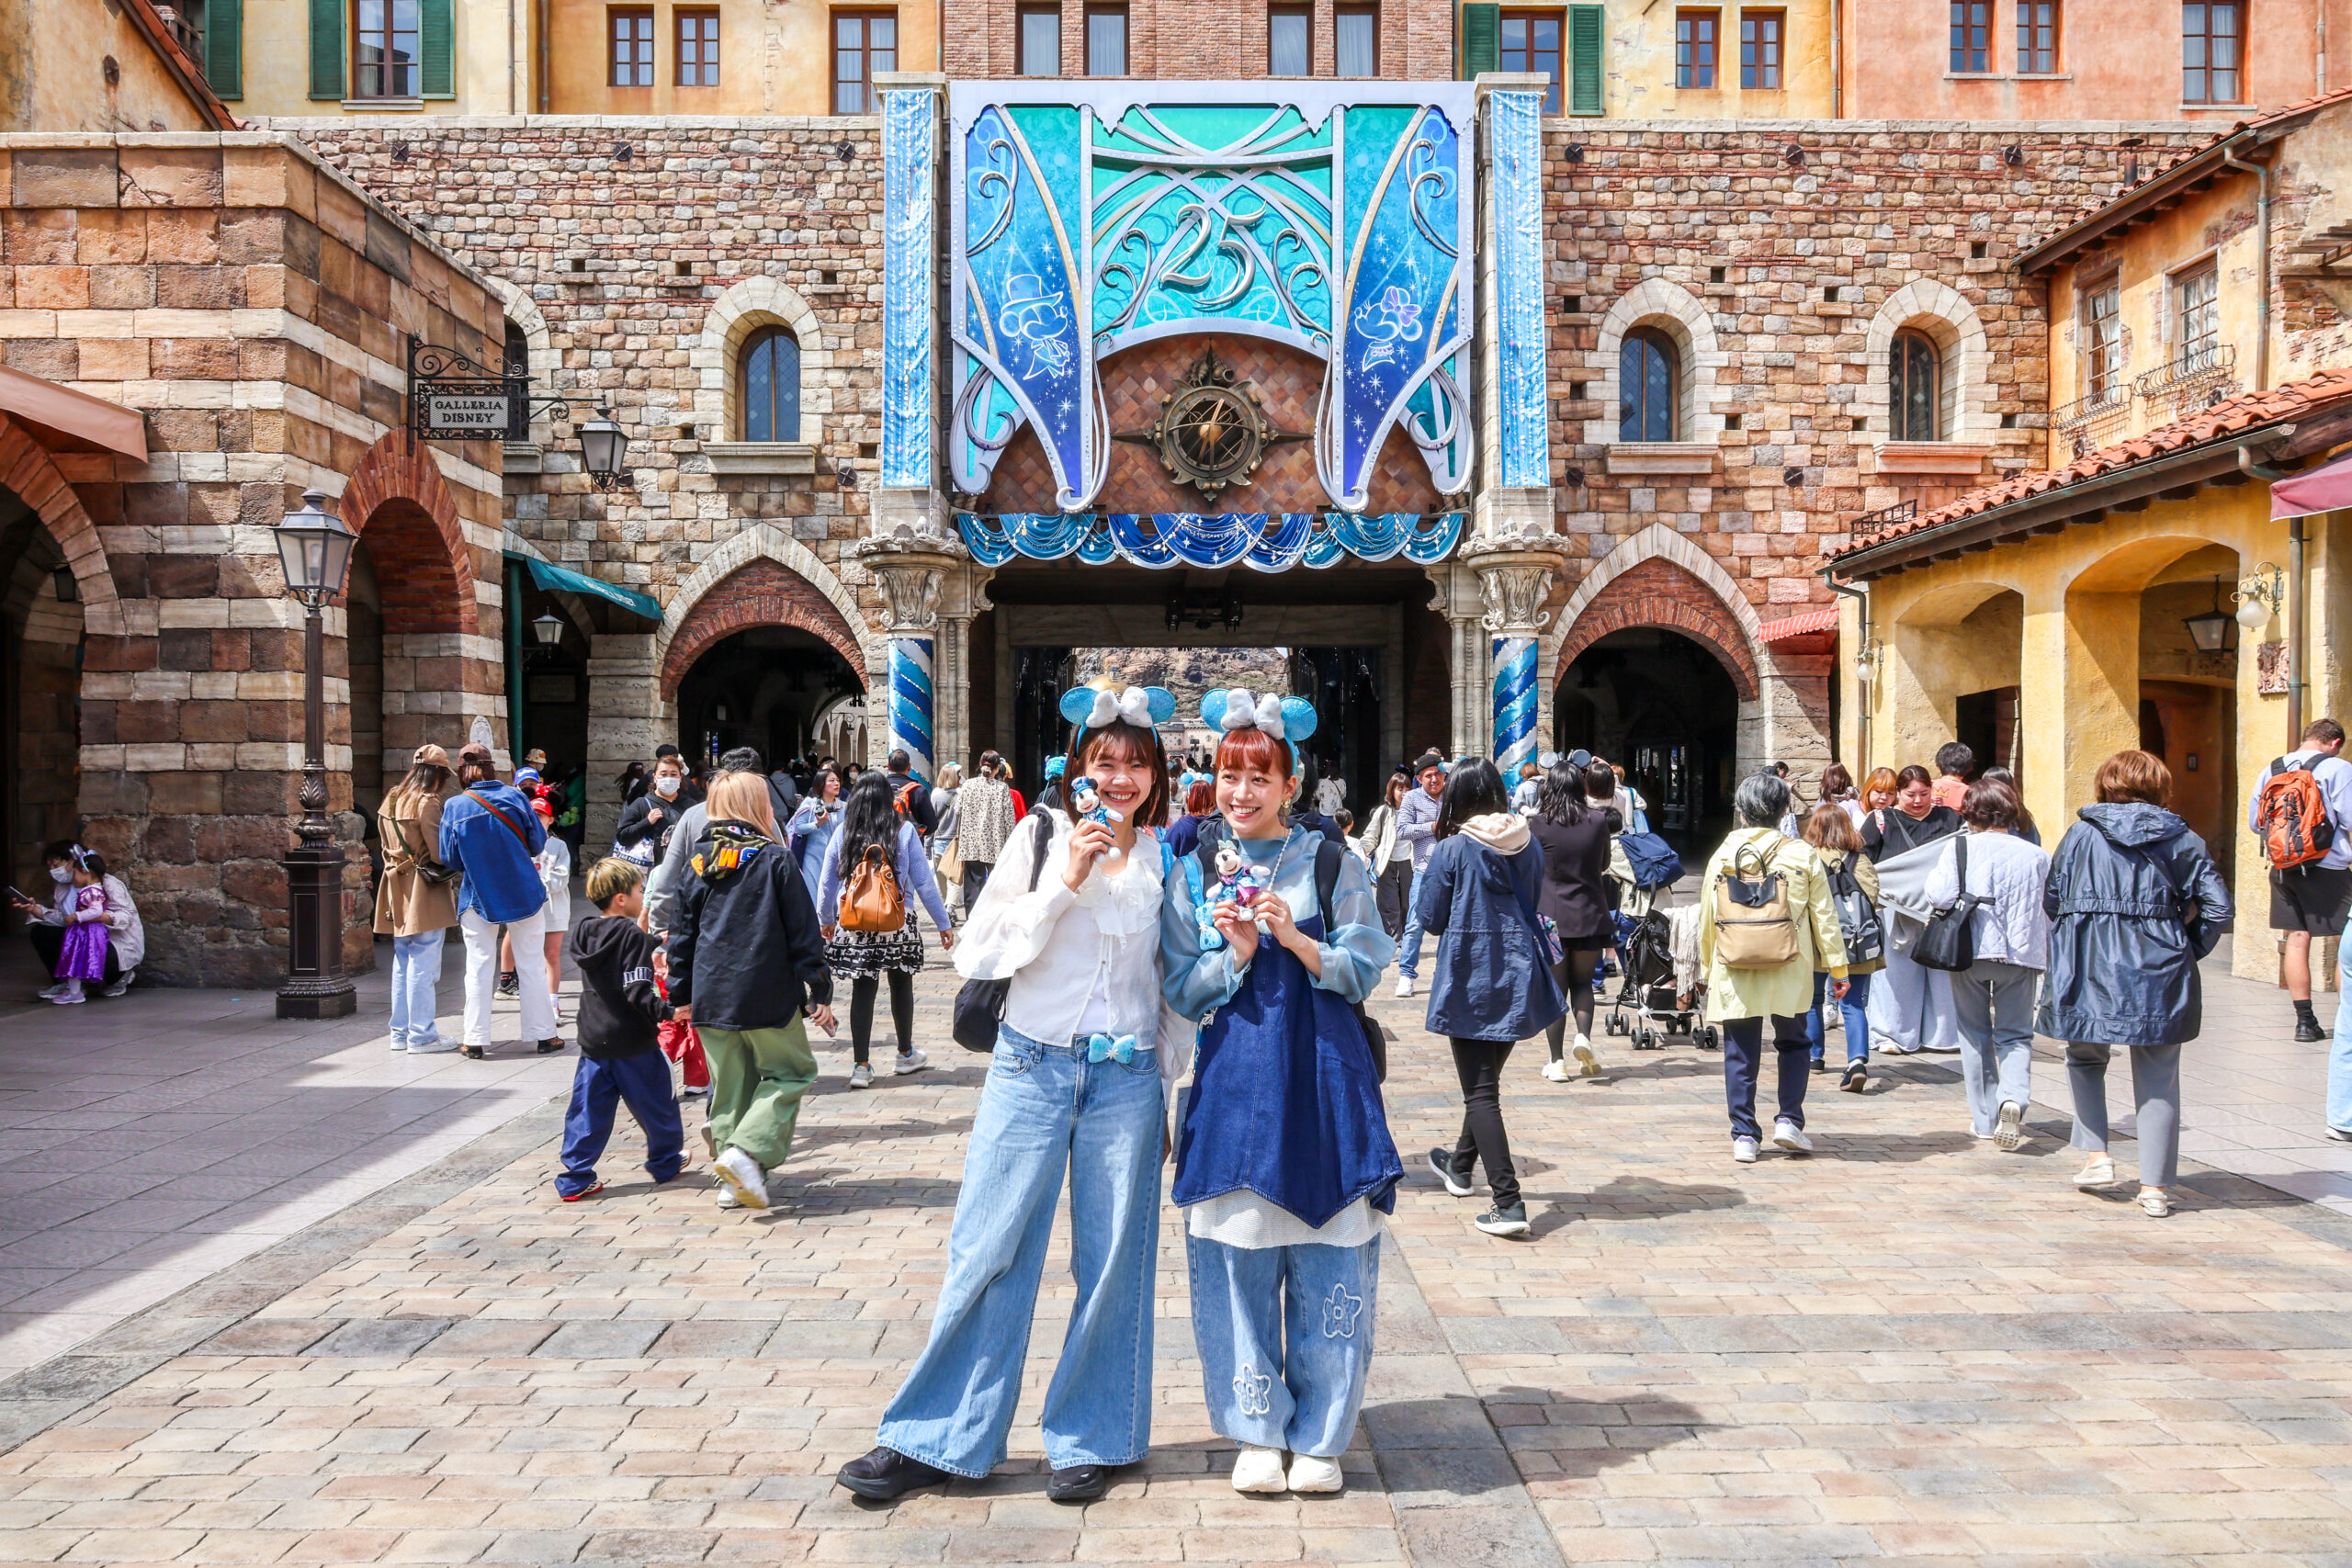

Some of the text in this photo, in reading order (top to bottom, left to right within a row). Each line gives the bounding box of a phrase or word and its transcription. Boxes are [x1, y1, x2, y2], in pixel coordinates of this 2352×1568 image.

[1158, 198, 1267, 306] 25
[435, 400, 503, 410] GALLERIA
[442, 412, 495, 423] DISNEY
